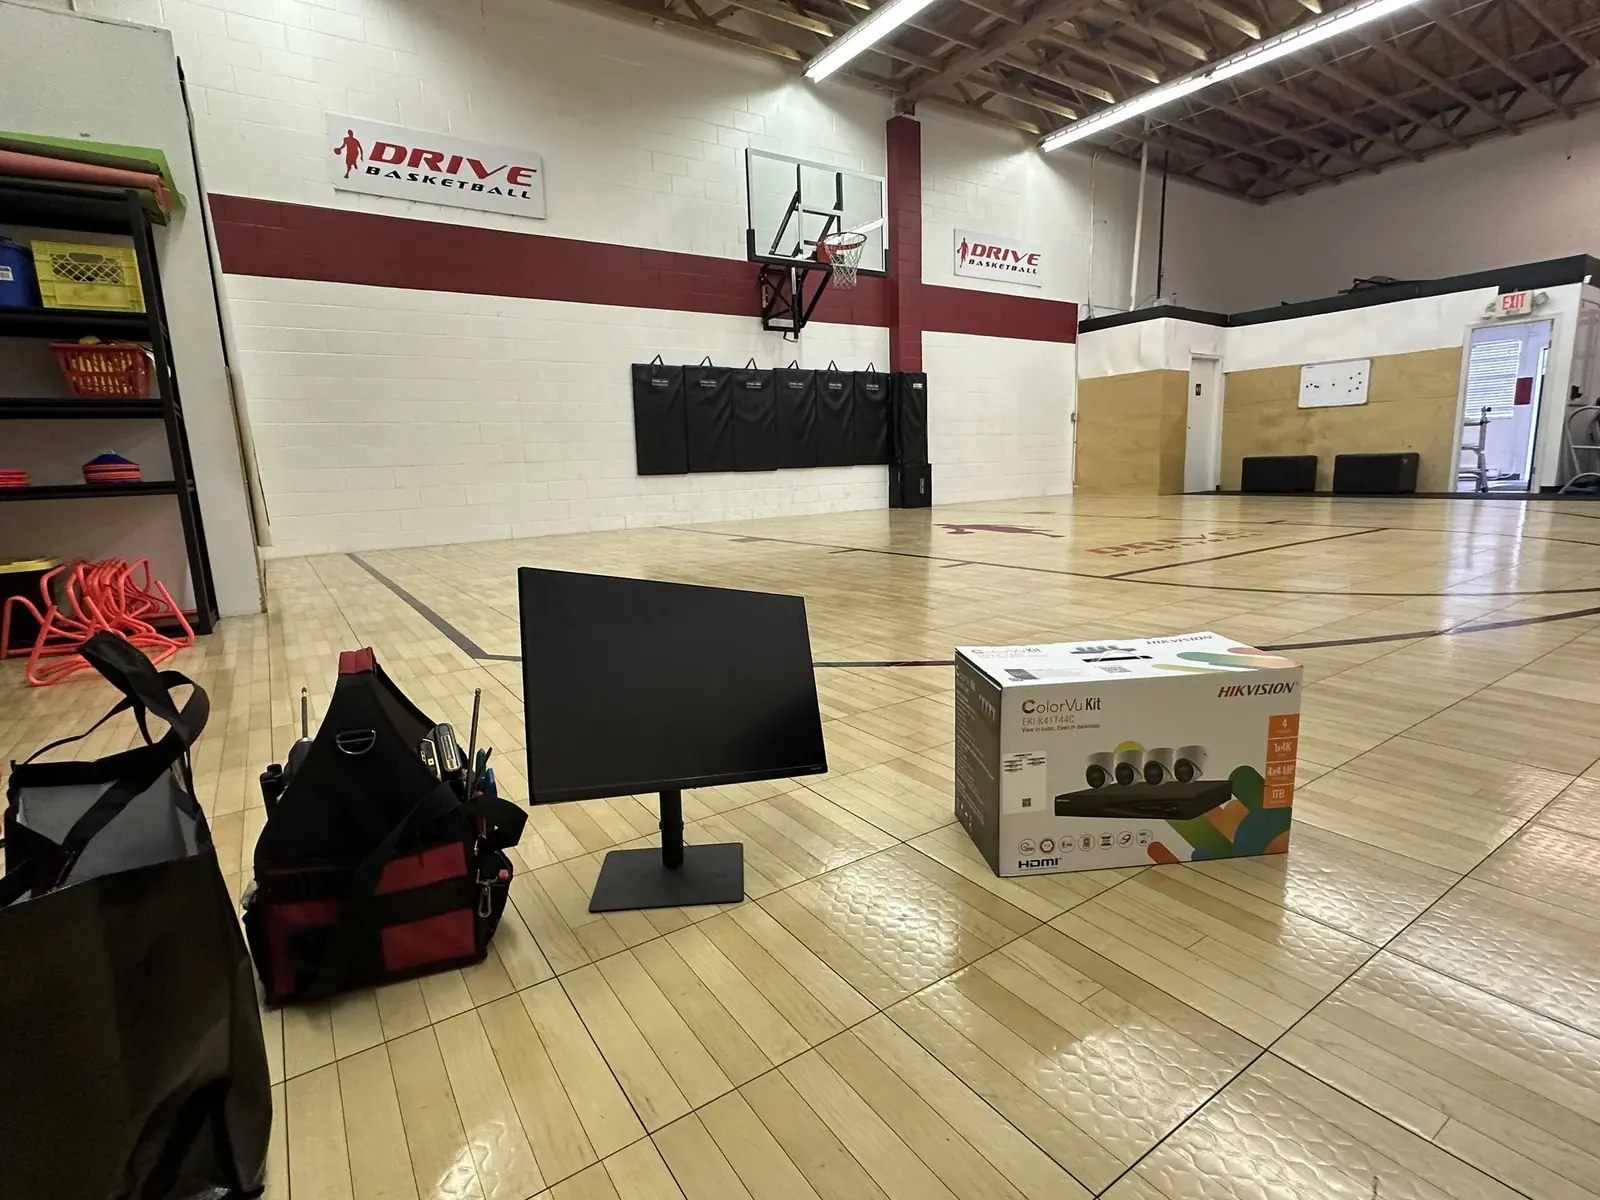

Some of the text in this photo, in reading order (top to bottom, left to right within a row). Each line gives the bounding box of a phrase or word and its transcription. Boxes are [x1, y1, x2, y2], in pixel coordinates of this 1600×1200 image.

[368, 141, 538, 188] DRIVE
[365, 165, 532, 200] BASKETBALL
[970, 243, 1041, 266] DRIVE
[969, 259, 1037, 274] BASKETBALL
[1502, 292, 1527, 310] EXIT
[1085, 529, 1244, 554] DRIVE
[1146, 635, 1213, 645] HIKVISION
[1217, 682, 1295, 698] HIKVISION
[1021, 697, 1102, 715] ColorVu Kit
[1281, 718, 1288, 729] 4
[1267, 764, 1295, 777] 4x4 MP
[1271, 788, 1285, 800] 1TB
[1018, 857, 1059, 869] HDMI
